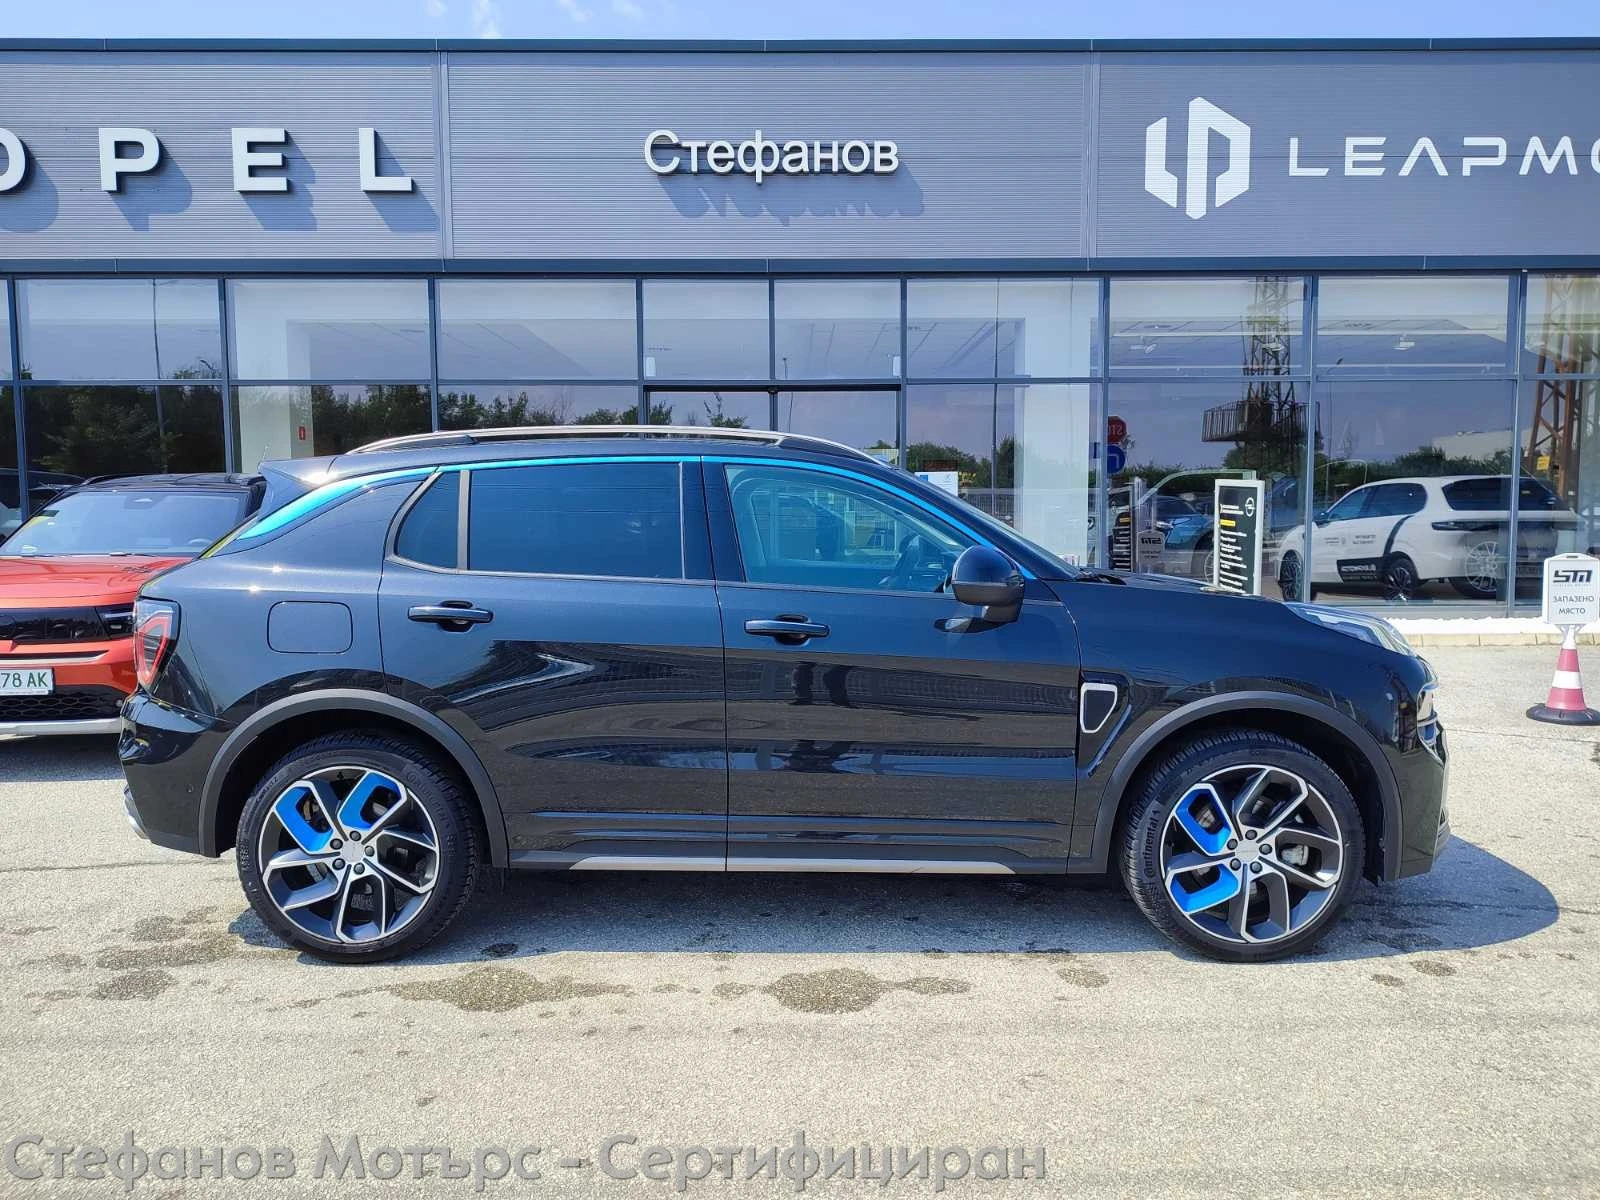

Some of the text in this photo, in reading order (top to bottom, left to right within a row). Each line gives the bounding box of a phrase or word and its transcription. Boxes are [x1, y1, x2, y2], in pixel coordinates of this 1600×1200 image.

[644, 129, 900, 185] Стефанов
[1288, 135, 1600, 177] LEAPM
[1552, 594, 1595, 603] ЗАПАЗЕНО
[1559, 607, 1586, 615] МЯСТО
[0, 671, 48, 688] 78 AK
